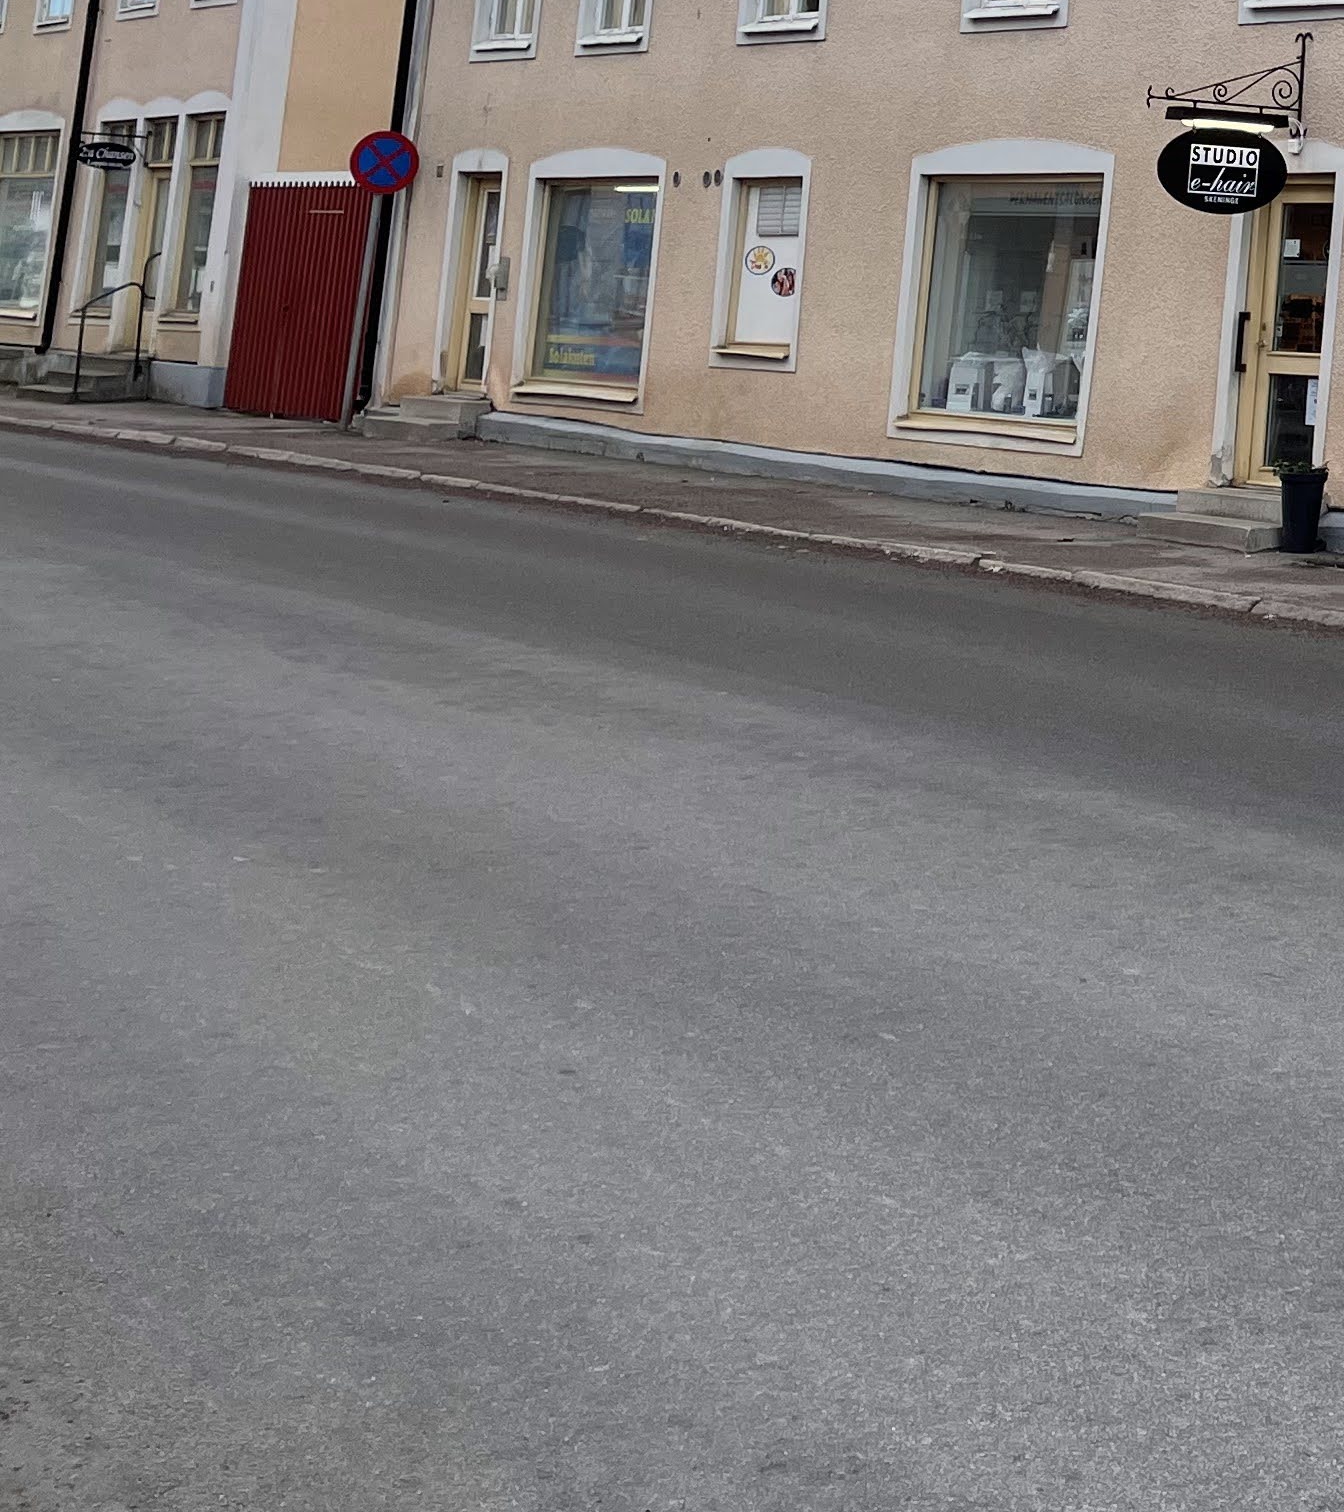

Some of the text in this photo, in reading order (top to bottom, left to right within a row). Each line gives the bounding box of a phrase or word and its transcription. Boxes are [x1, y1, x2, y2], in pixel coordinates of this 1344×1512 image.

[1192, 146, 1257, 166] STUDIO
[1191, 167, 1255, 193] e-hair
[624, 208, 655, 224] SOLA
